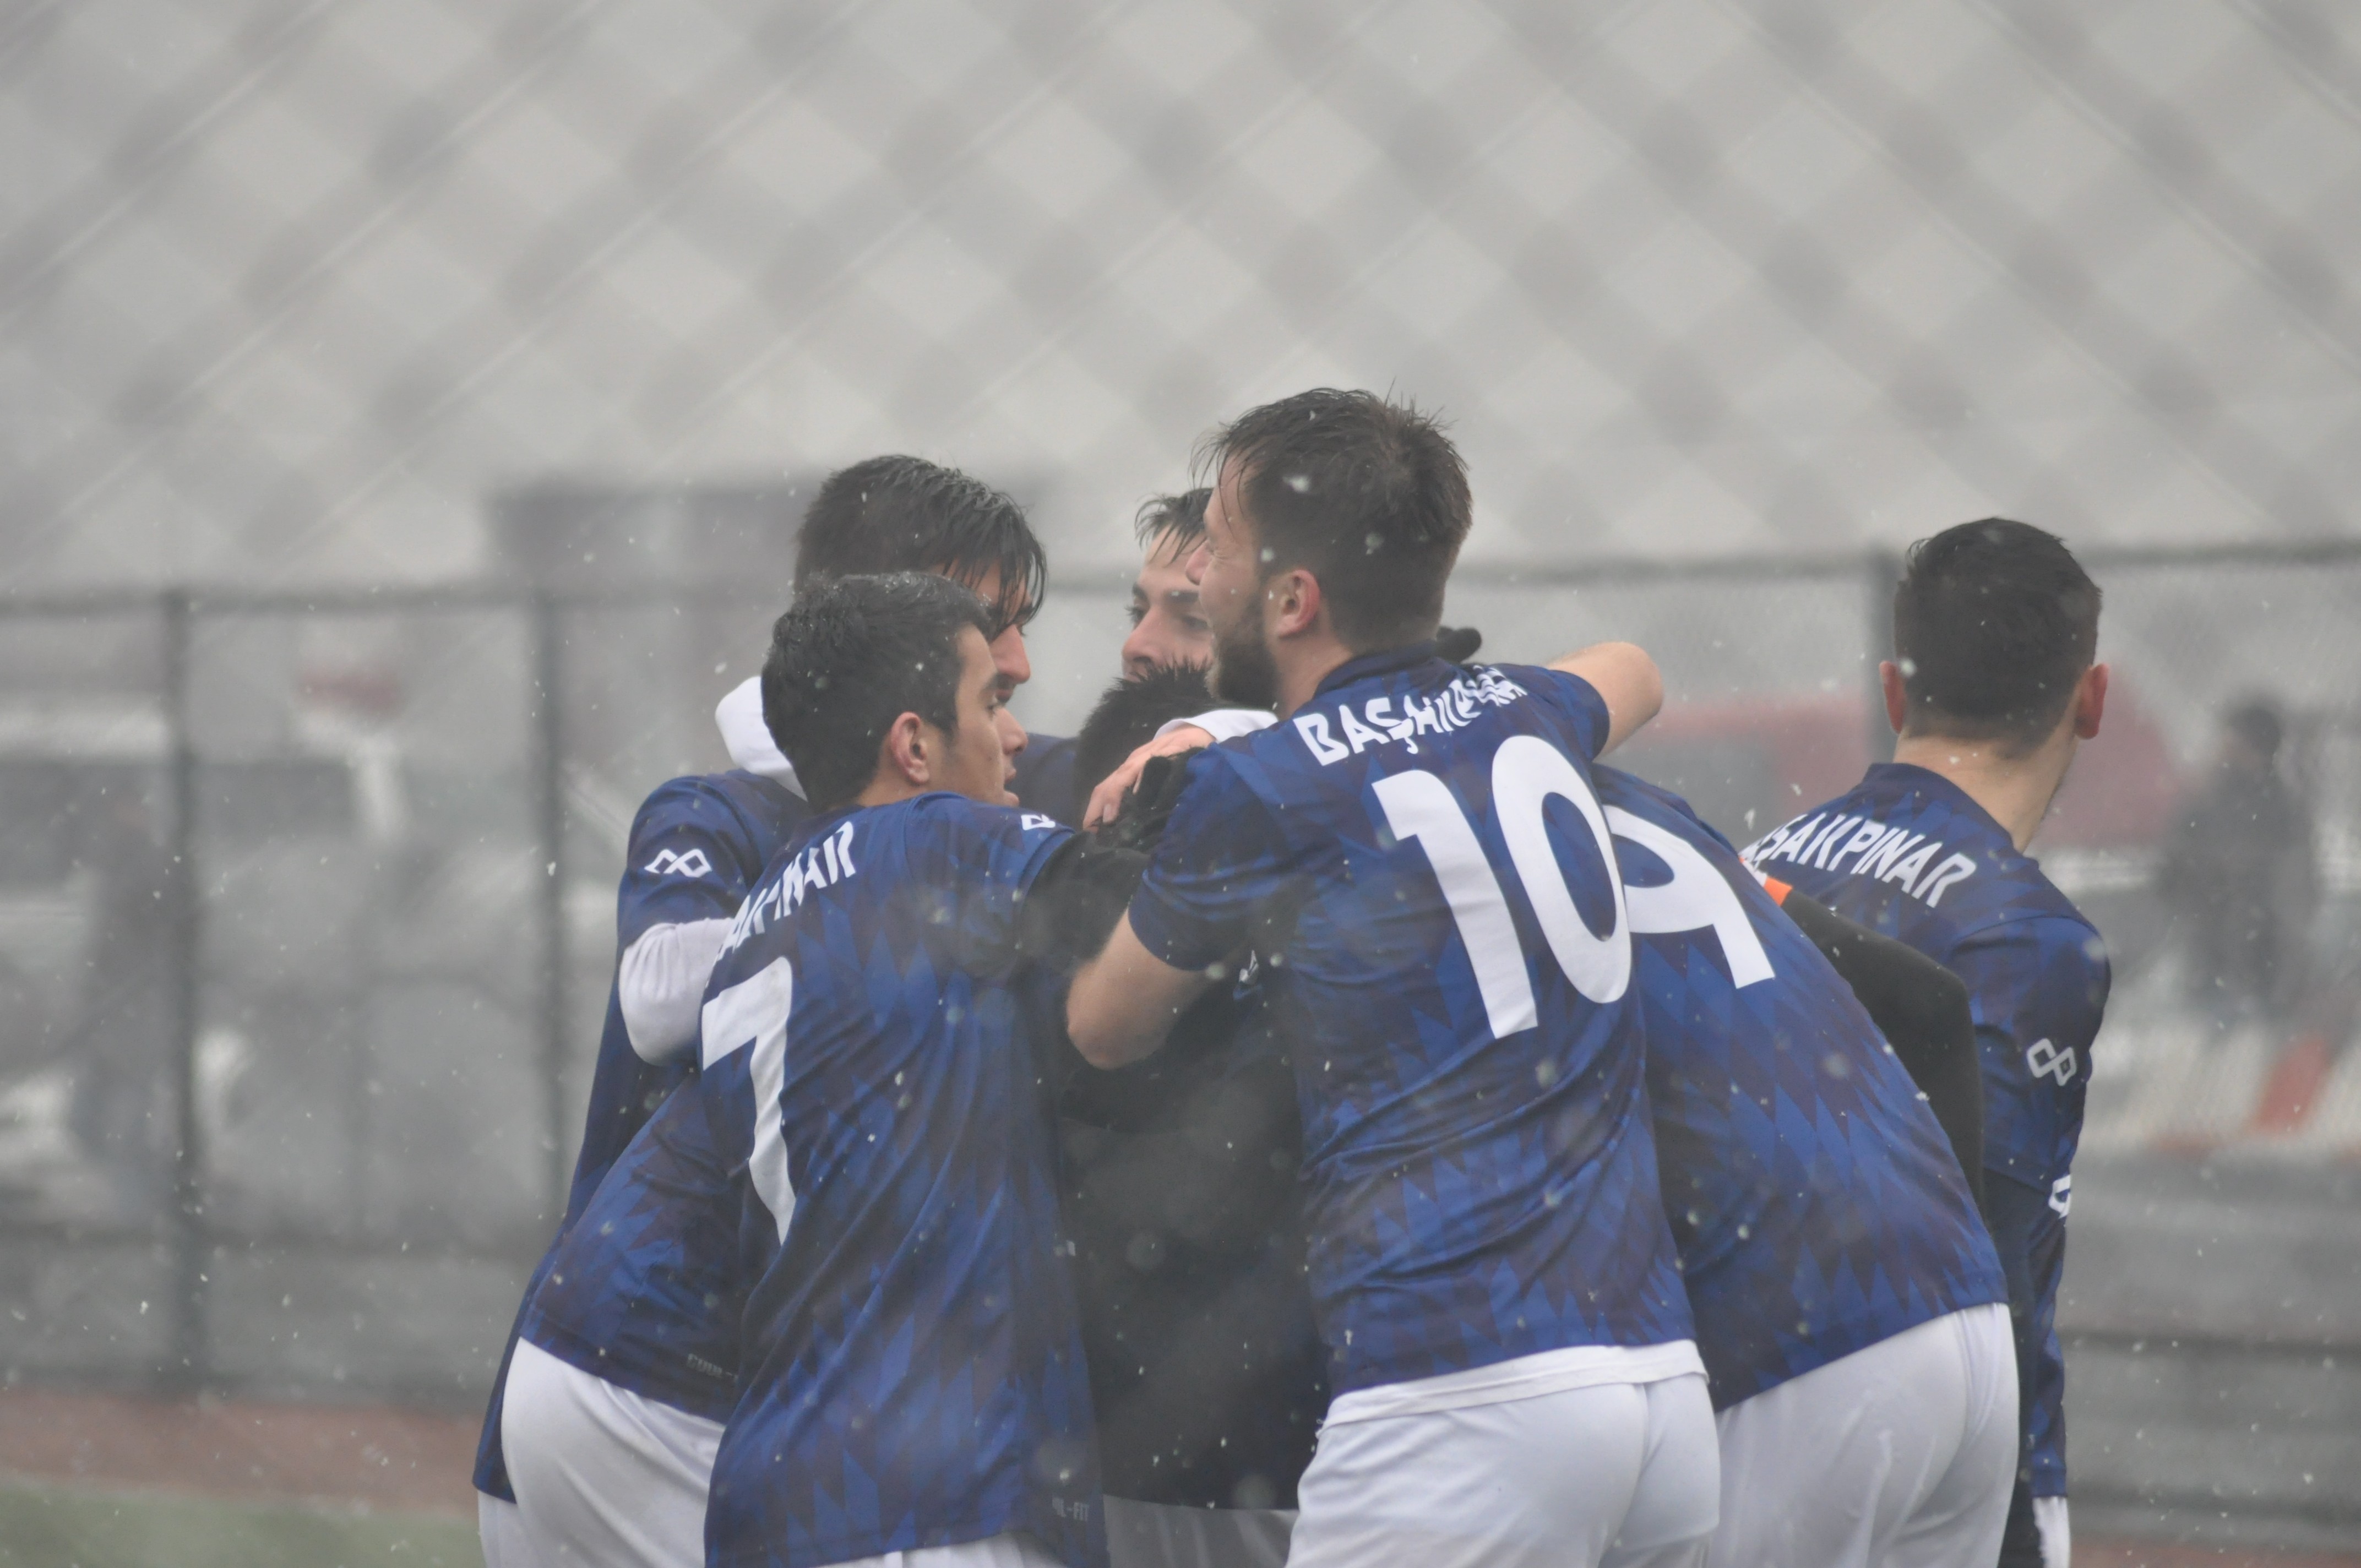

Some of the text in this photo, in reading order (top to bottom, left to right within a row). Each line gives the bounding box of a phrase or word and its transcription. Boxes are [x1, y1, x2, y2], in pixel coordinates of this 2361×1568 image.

[1293, 665, 1528, 766] BAŞAKP
[1371, 735, 1633, 1039] 10
[701, 956, 796, 1246] 7
